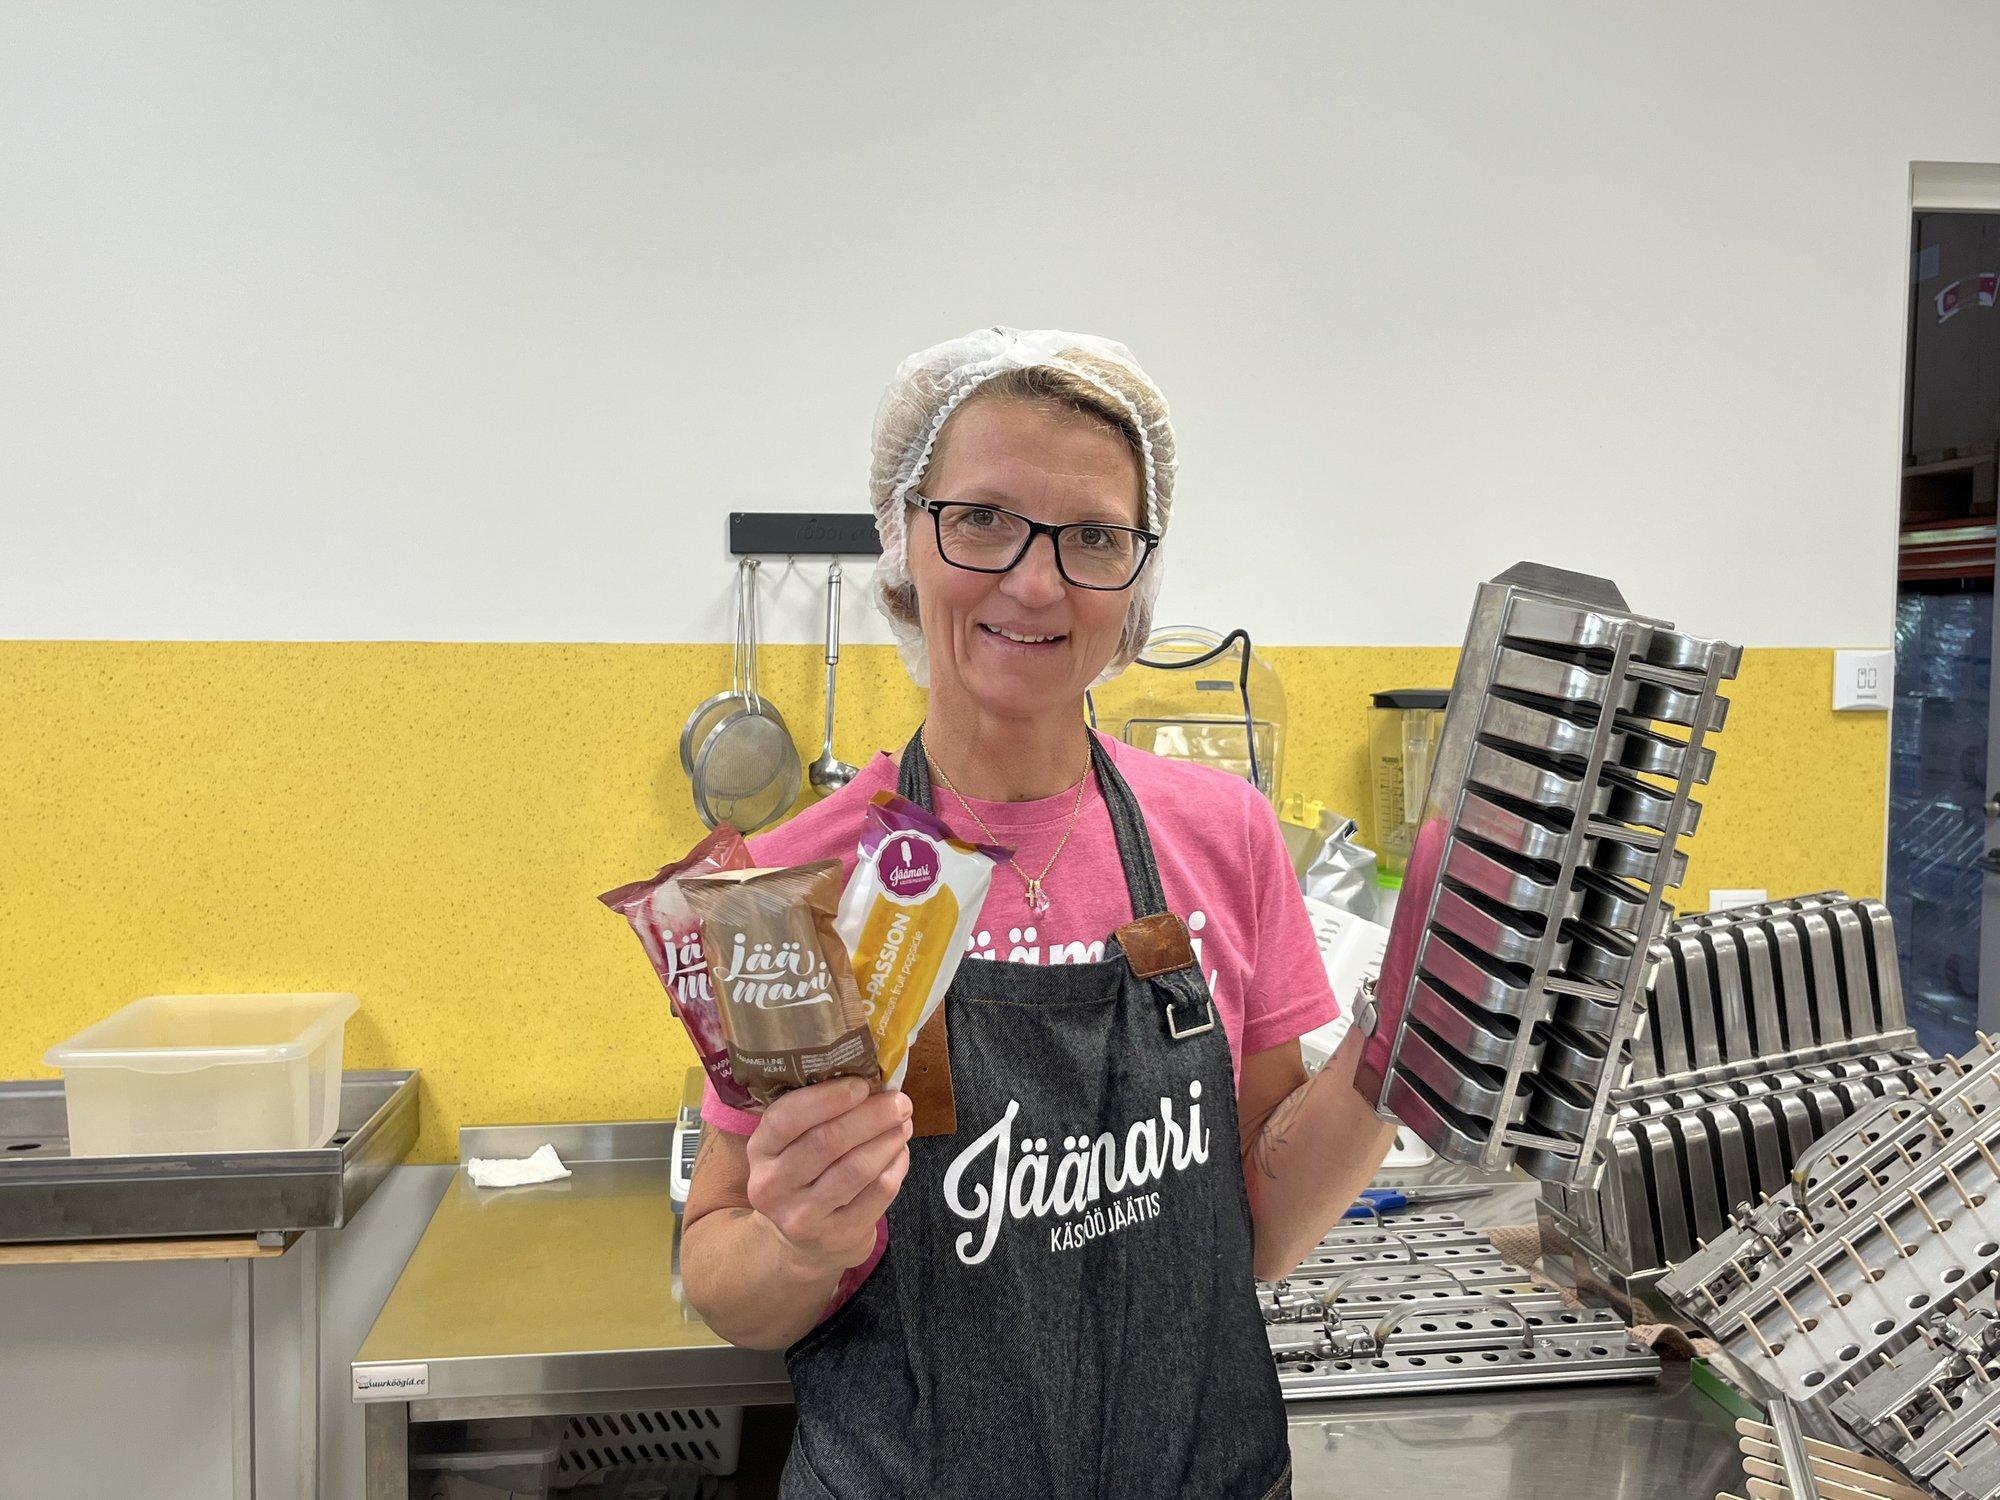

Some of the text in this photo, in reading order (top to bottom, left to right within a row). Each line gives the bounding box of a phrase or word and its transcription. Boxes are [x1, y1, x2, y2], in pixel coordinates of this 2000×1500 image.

[713, 932, 815, 982] jää
[891, 975, 905, 995] fruit
[901, 930, 924, 975] popsicle
[732, 961, 833, 1010] mari
